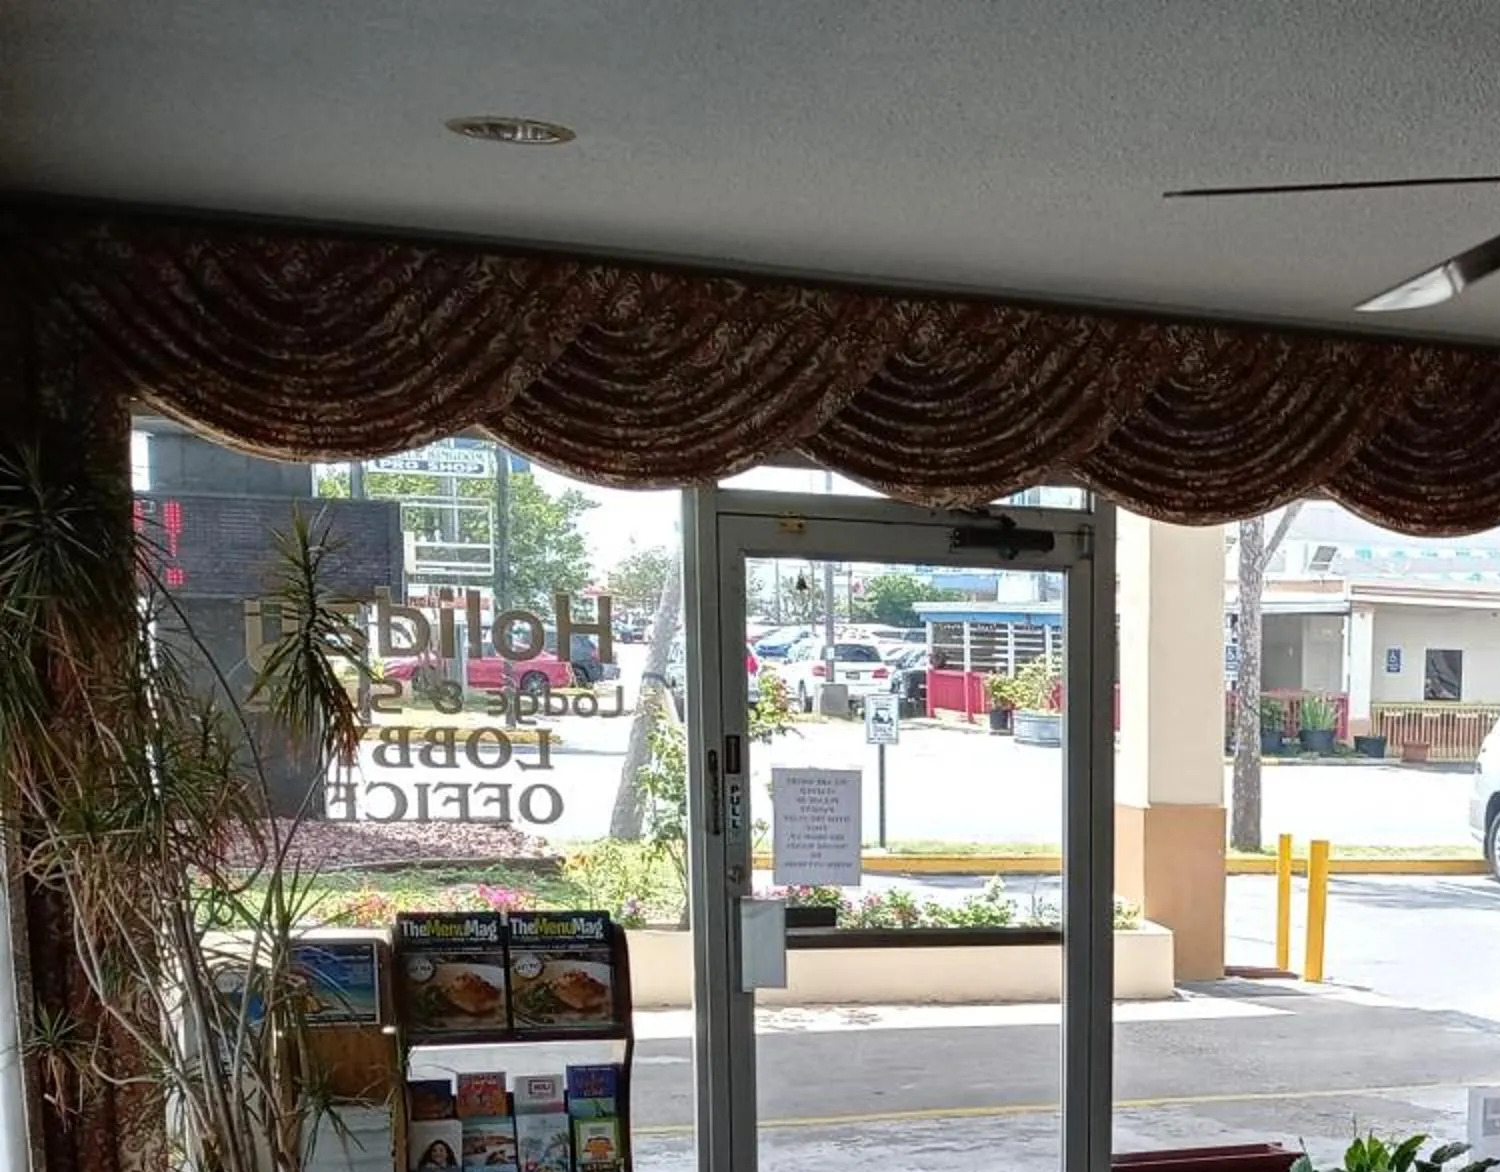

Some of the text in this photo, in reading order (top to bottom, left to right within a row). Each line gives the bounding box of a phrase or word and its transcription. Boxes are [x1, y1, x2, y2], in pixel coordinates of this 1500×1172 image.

[378, 459, 480, 473] PRO SHOP
[730, 784, 741, 829] PULL
